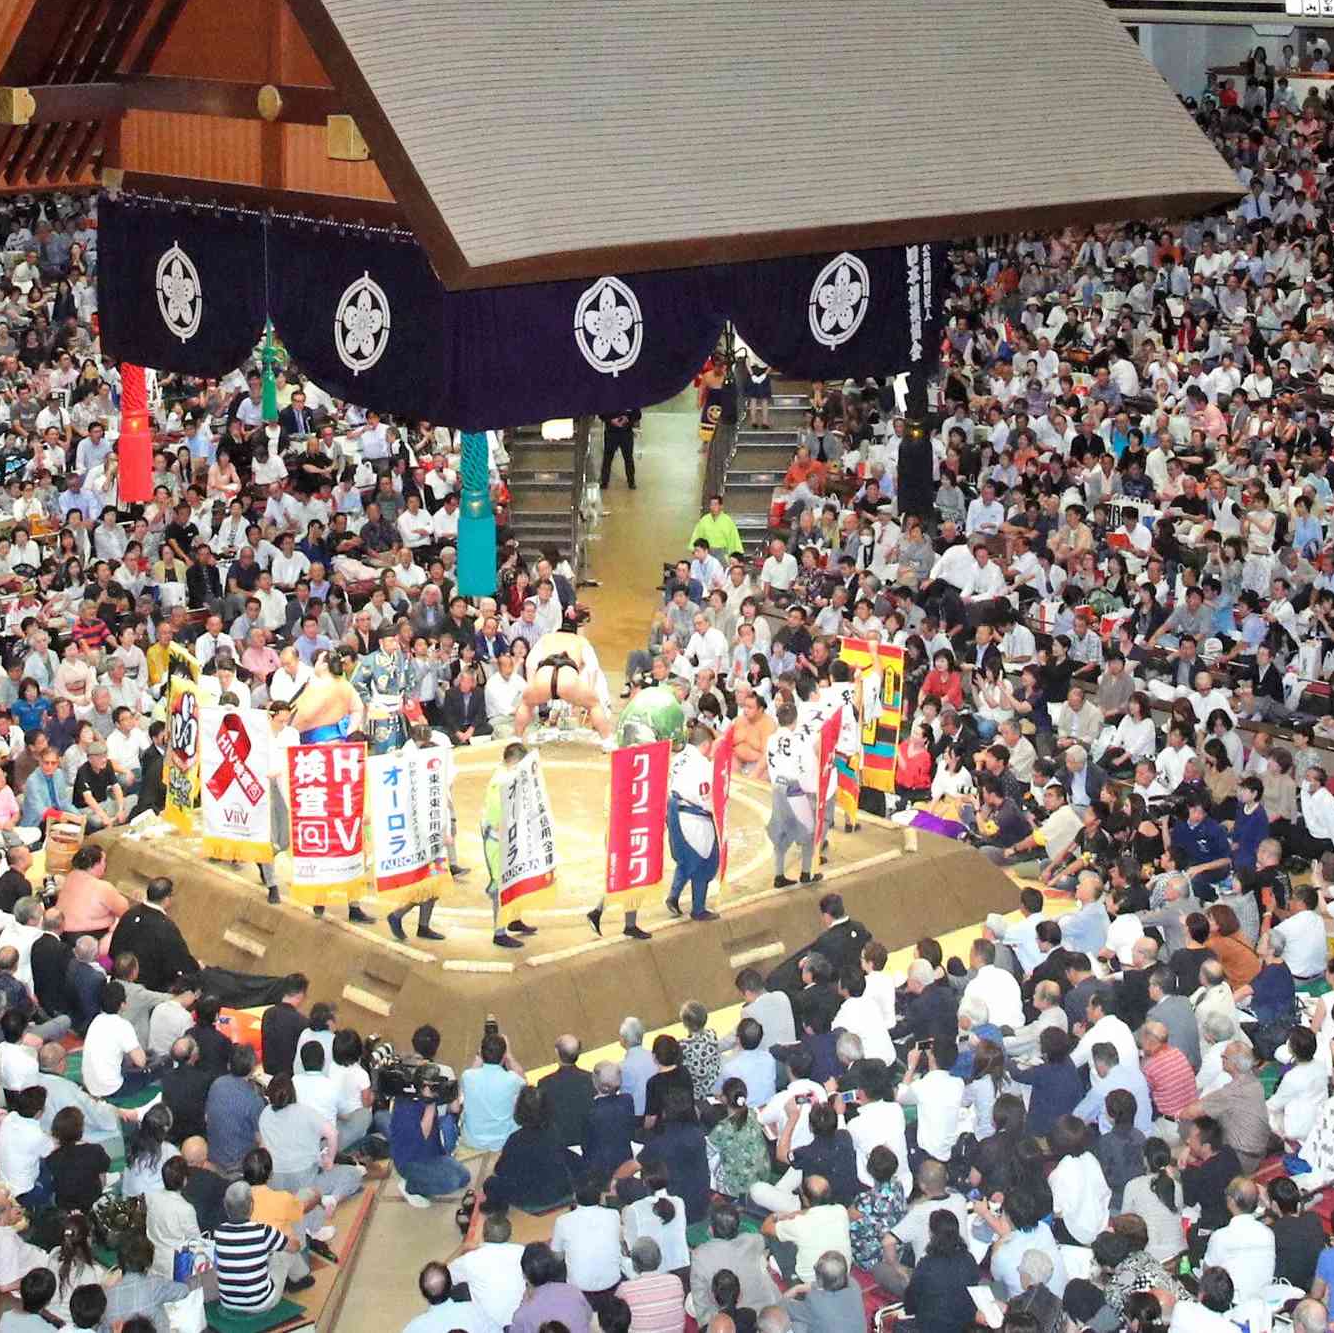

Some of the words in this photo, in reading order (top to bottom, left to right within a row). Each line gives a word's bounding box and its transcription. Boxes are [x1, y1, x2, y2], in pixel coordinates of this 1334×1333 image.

[295, 748, 329, 817] 検査
[333, 747, 361, 851] HIV
[382, 766, 407, 856] オーロラ
[630, 754, 651, 885] クリニック
